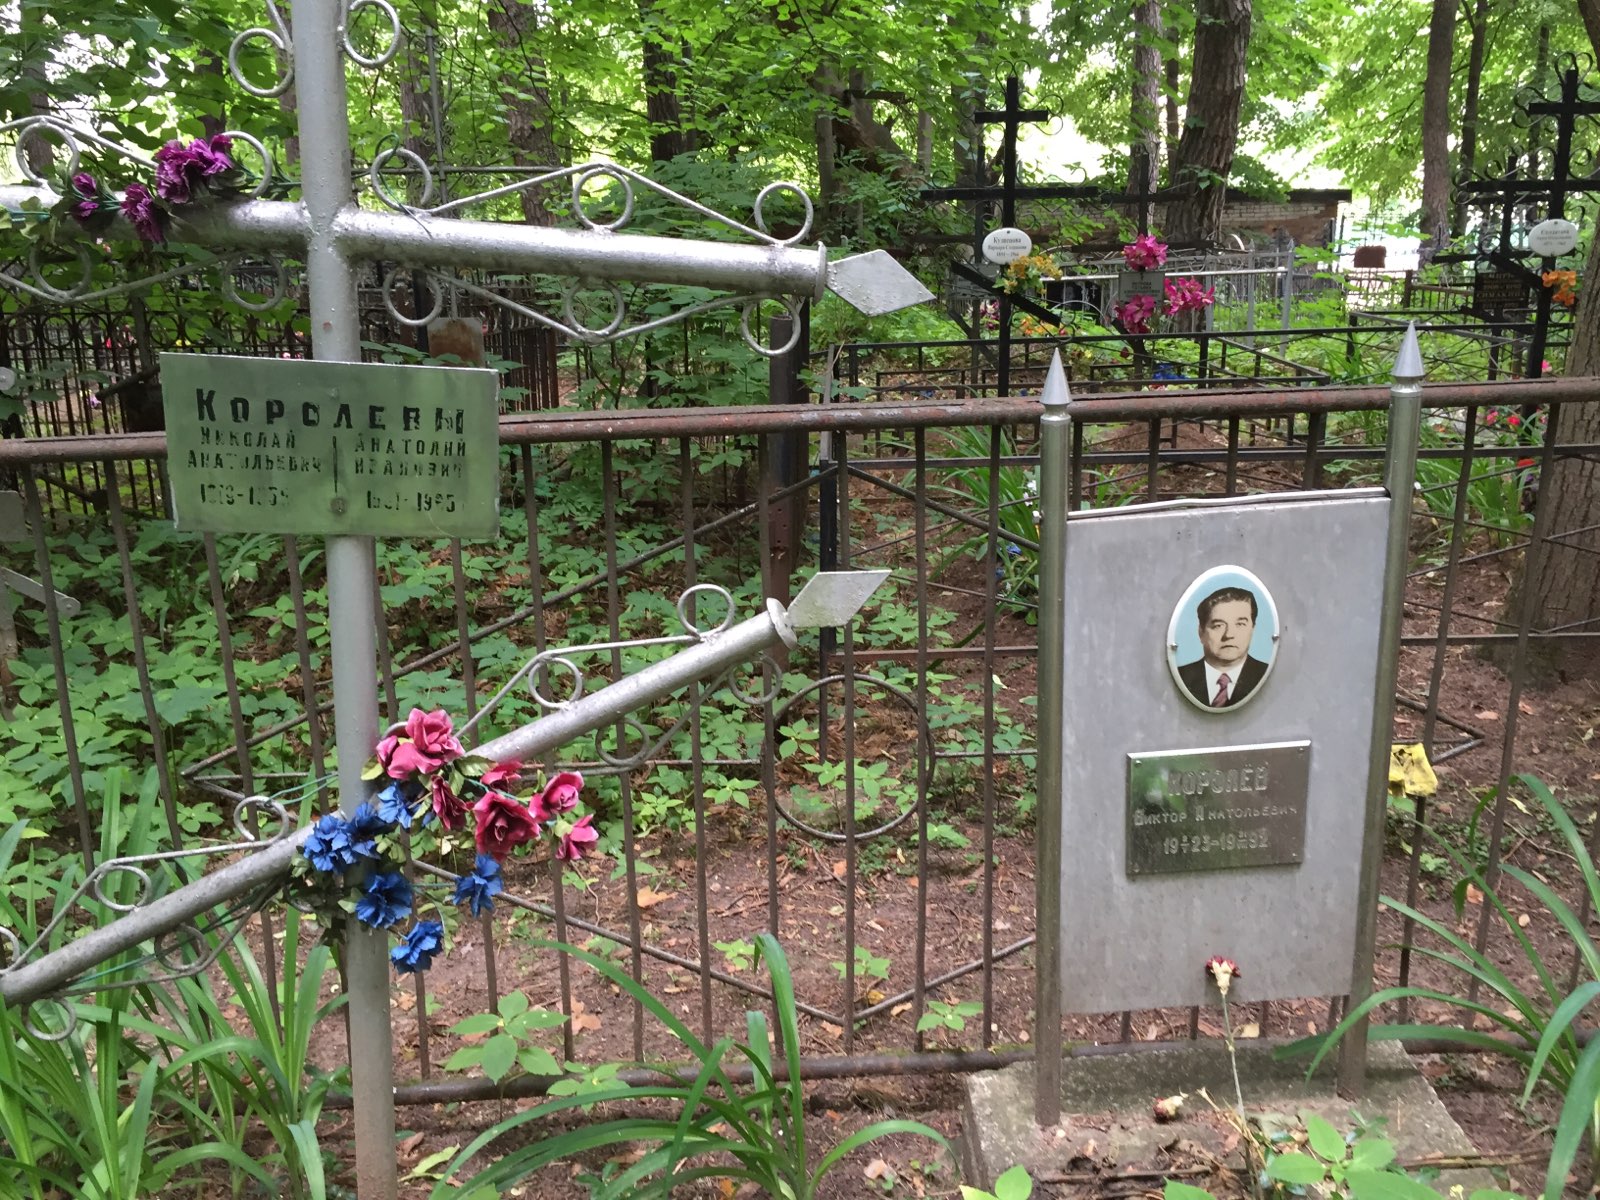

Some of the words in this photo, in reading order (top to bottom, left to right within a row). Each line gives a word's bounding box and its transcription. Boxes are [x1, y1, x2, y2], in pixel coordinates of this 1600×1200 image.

[195, 388, 464, 435] КОРОЛЕВЫ
[200, 427, 296, 450] НИКОЛАЙ
[354, 431, 467, 457] АНАТОЛИЙ
